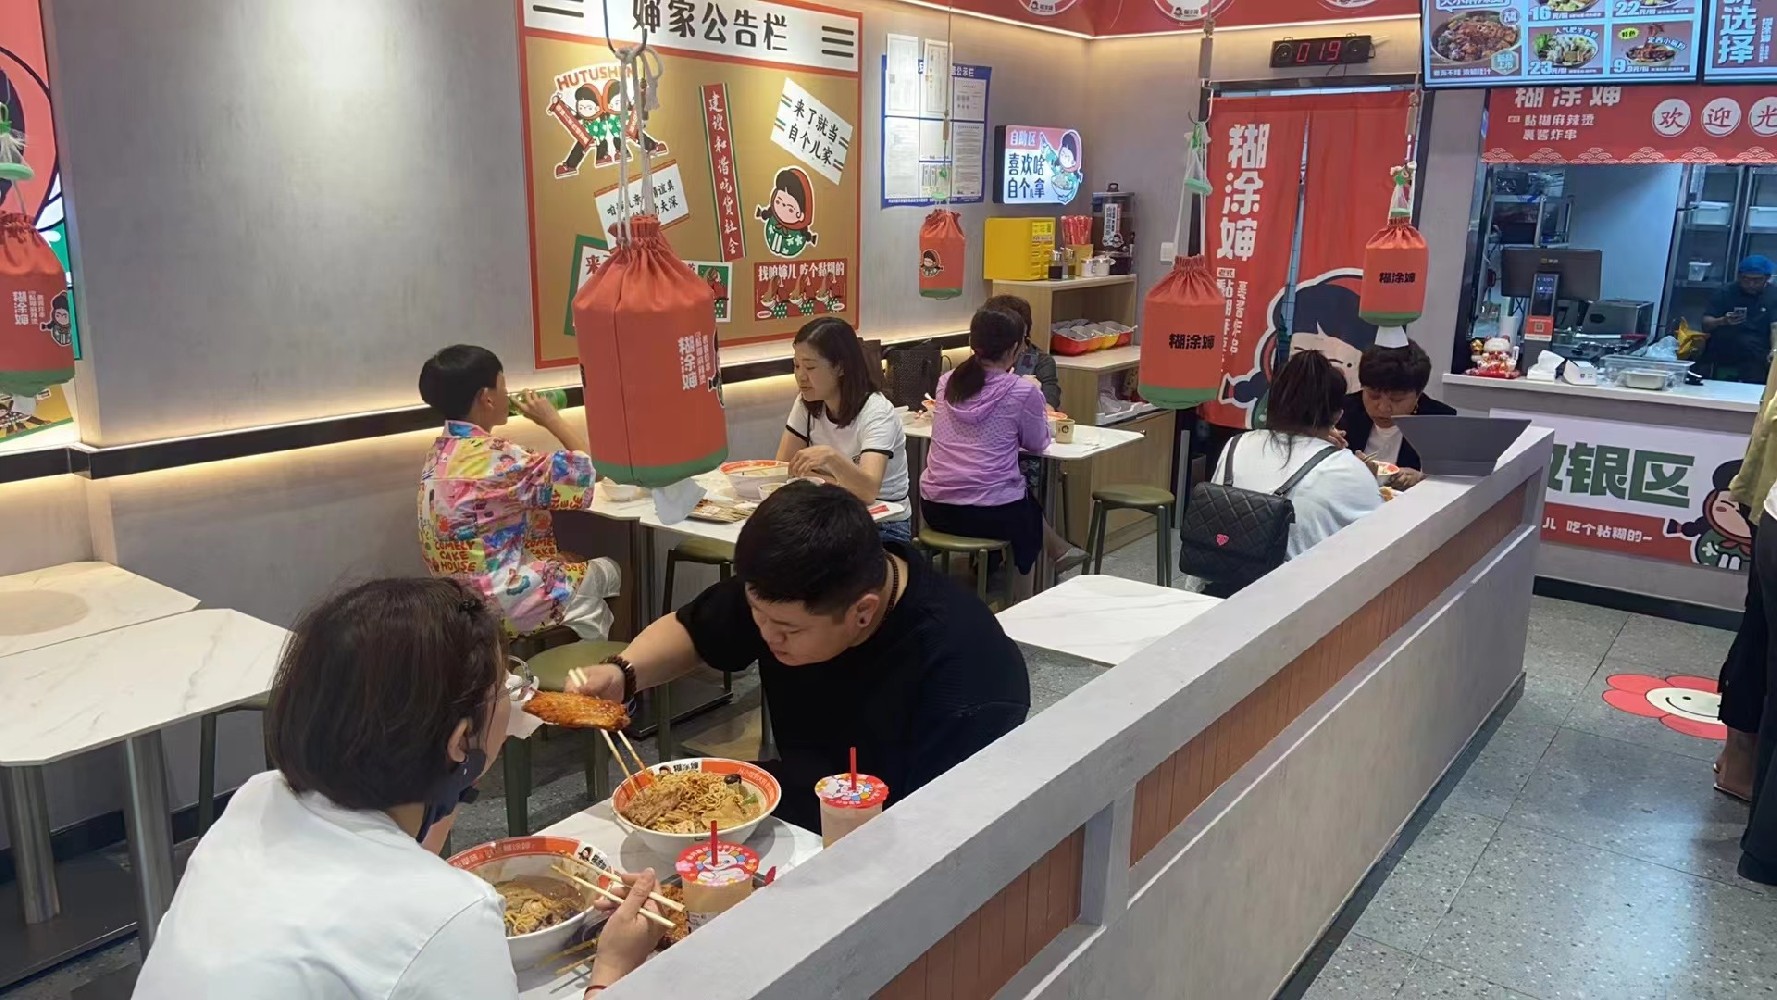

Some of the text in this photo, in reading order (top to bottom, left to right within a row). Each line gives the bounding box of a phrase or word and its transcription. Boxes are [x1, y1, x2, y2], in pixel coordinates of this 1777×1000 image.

[793, 99, 839, 143] 来了就当
[787, 123, 834, 167] 自个儿家
[1008, 153, 1045, 176] 喜欢啥
[708, 91, 740, 256] 建设和谐吃货社会
[1216, 124, 1270, 261] 糊涂婶
[1379, 272, 1416, 284] 糊涂婶
[1169, 333, 1215, 350] 糊涂婶
